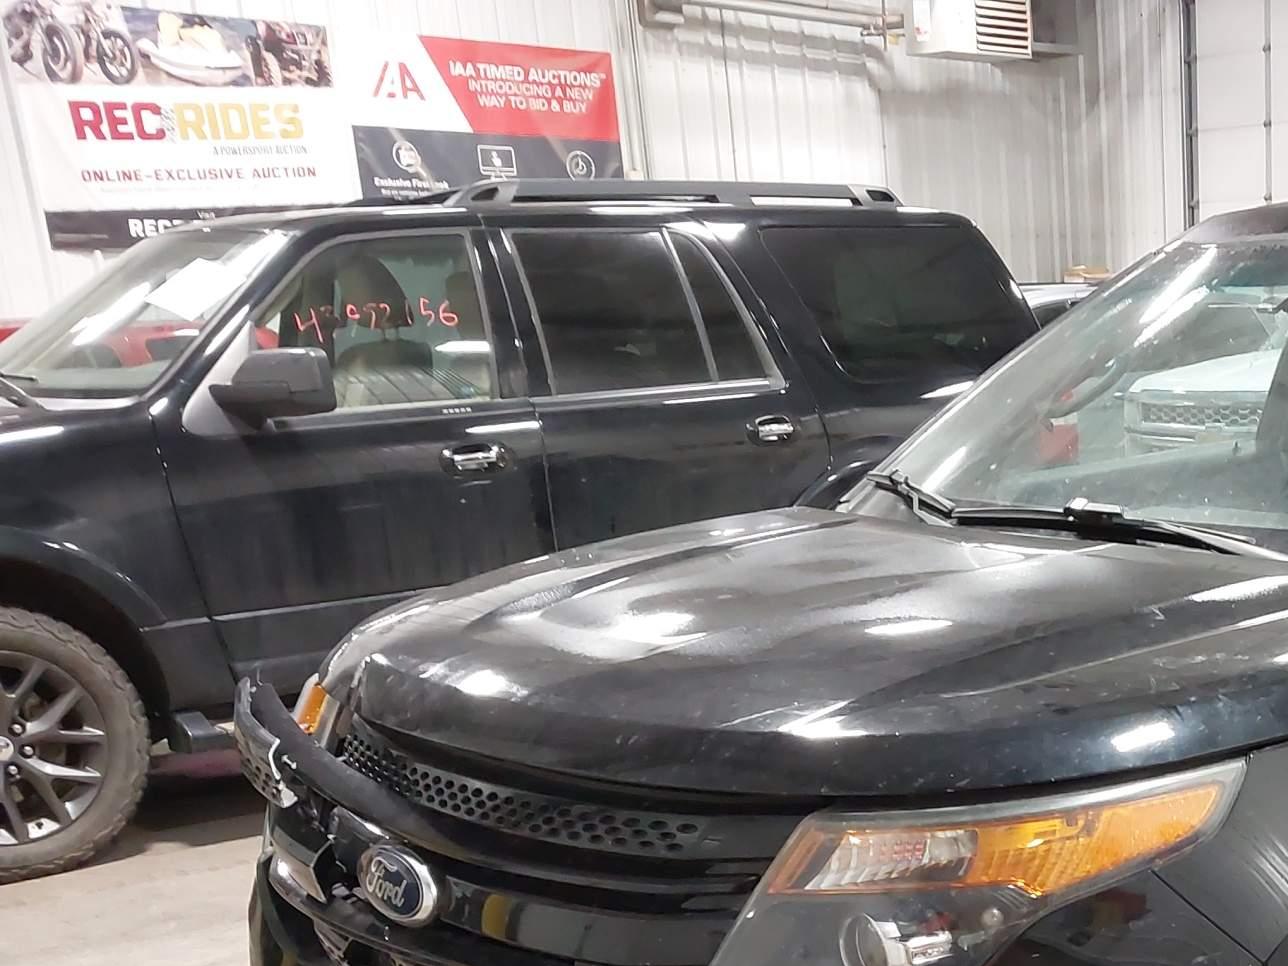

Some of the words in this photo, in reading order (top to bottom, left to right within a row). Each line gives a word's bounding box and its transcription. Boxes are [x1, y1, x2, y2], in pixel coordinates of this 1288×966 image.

[449, 60, 475, 77] IAA
[476, 62, 524, 81] TIMED
[468, 80, 553, 98] INTRODUCING
[555, 87, 566, 99] A
[566, 88, 593, 101] NEW
[477, 95, 506, 109] WAY
[511, 97, 527, 110] TO
[529, 99, 548, 111] BID
[551, 101, 561, 112] &
[563, 101, 587, 113] BUY
[67, 100, 166, 141] REC
[173, 103, 304, 141] RIDES
[81, 167, 245, 182] ONLINE-EXCLUSIVE
[252, 166, 317, 179] AUCTION
[366, 856, 408, 908] Ford
